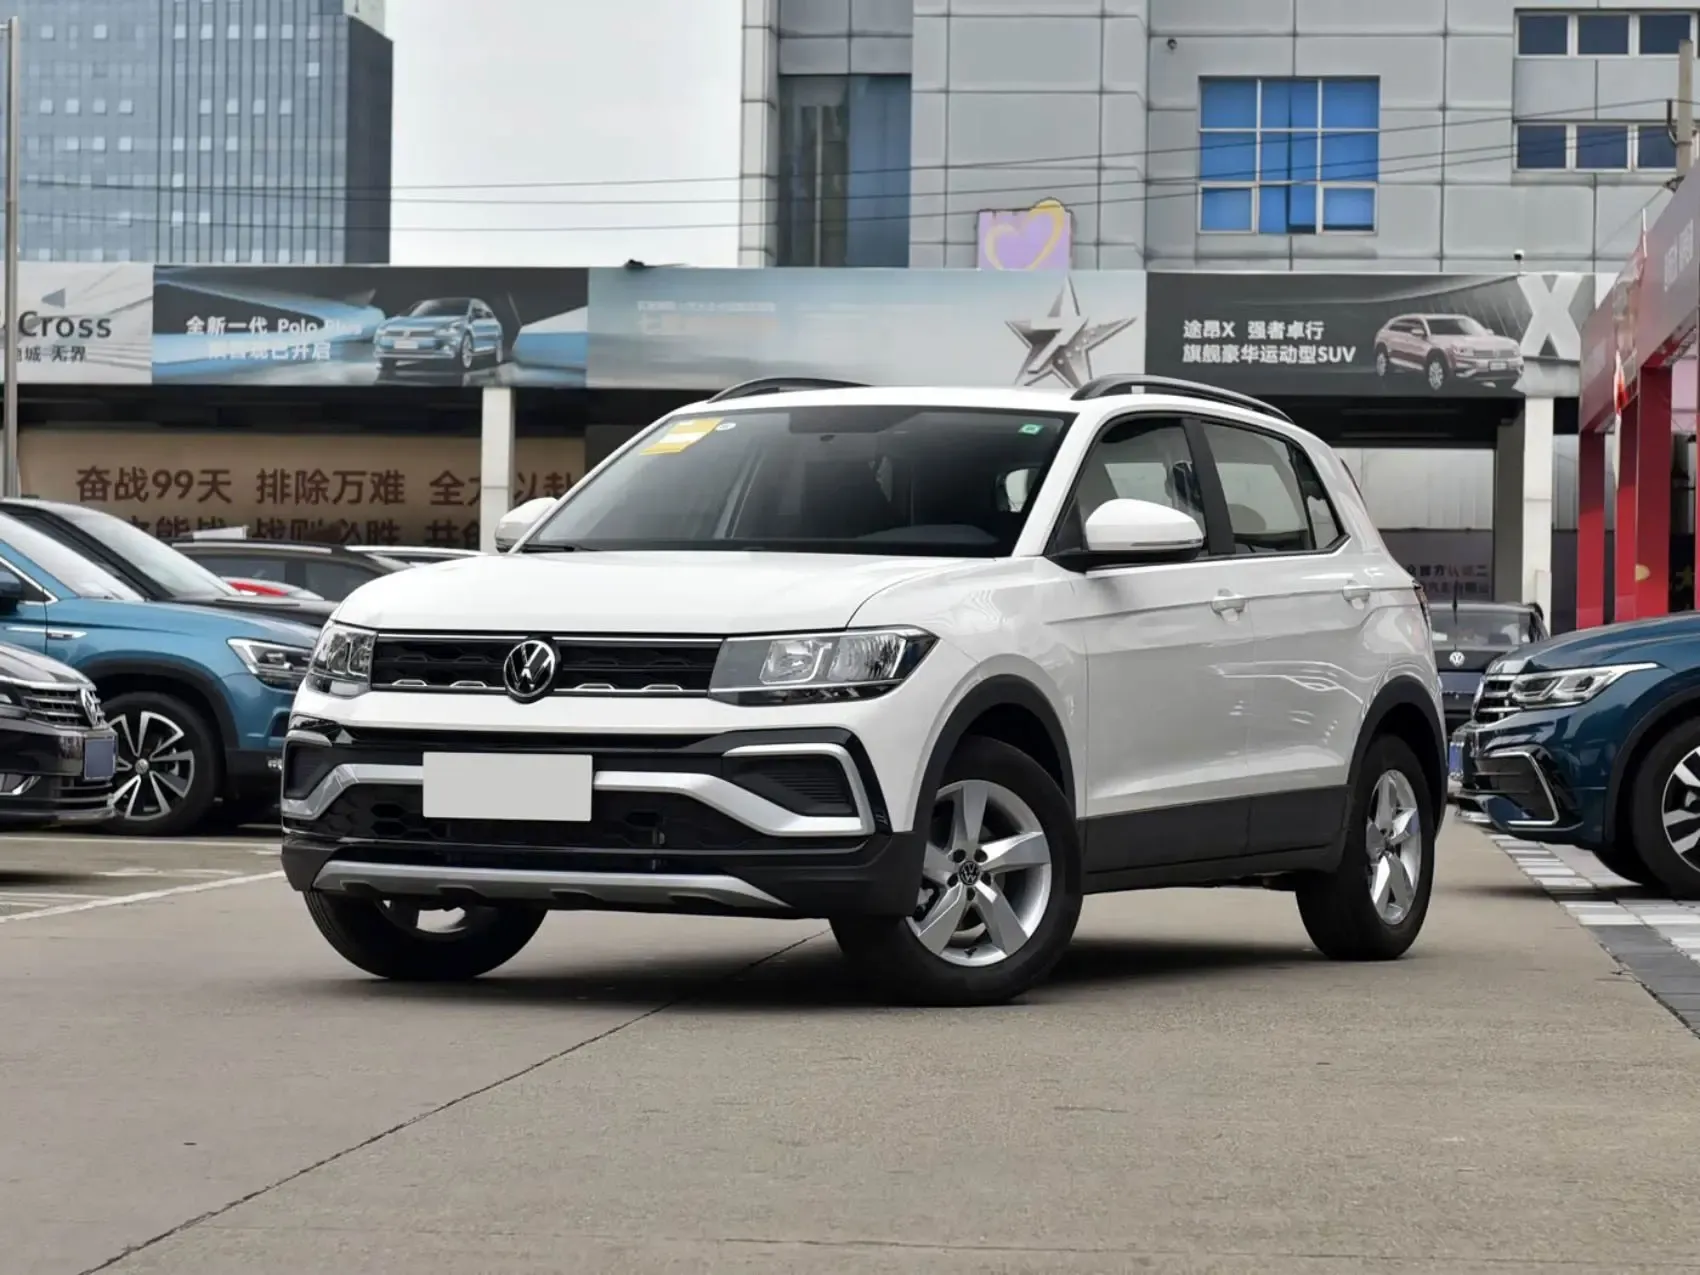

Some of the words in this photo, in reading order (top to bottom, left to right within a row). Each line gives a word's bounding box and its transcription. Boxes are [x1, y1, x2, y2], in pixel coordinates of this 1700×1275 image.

[18, 310, 112, 338] Cross
[186, 315, 268, 335] 全新一代
[277, 317, 317, 333] Polo
[1183, 320, 1235, 339] 途昂X
[1248, 320, 1324, 340] 强者卓行
[76, 465, 232, 503] 奋战99天
[255, 468, 405, 505] 排除万难
